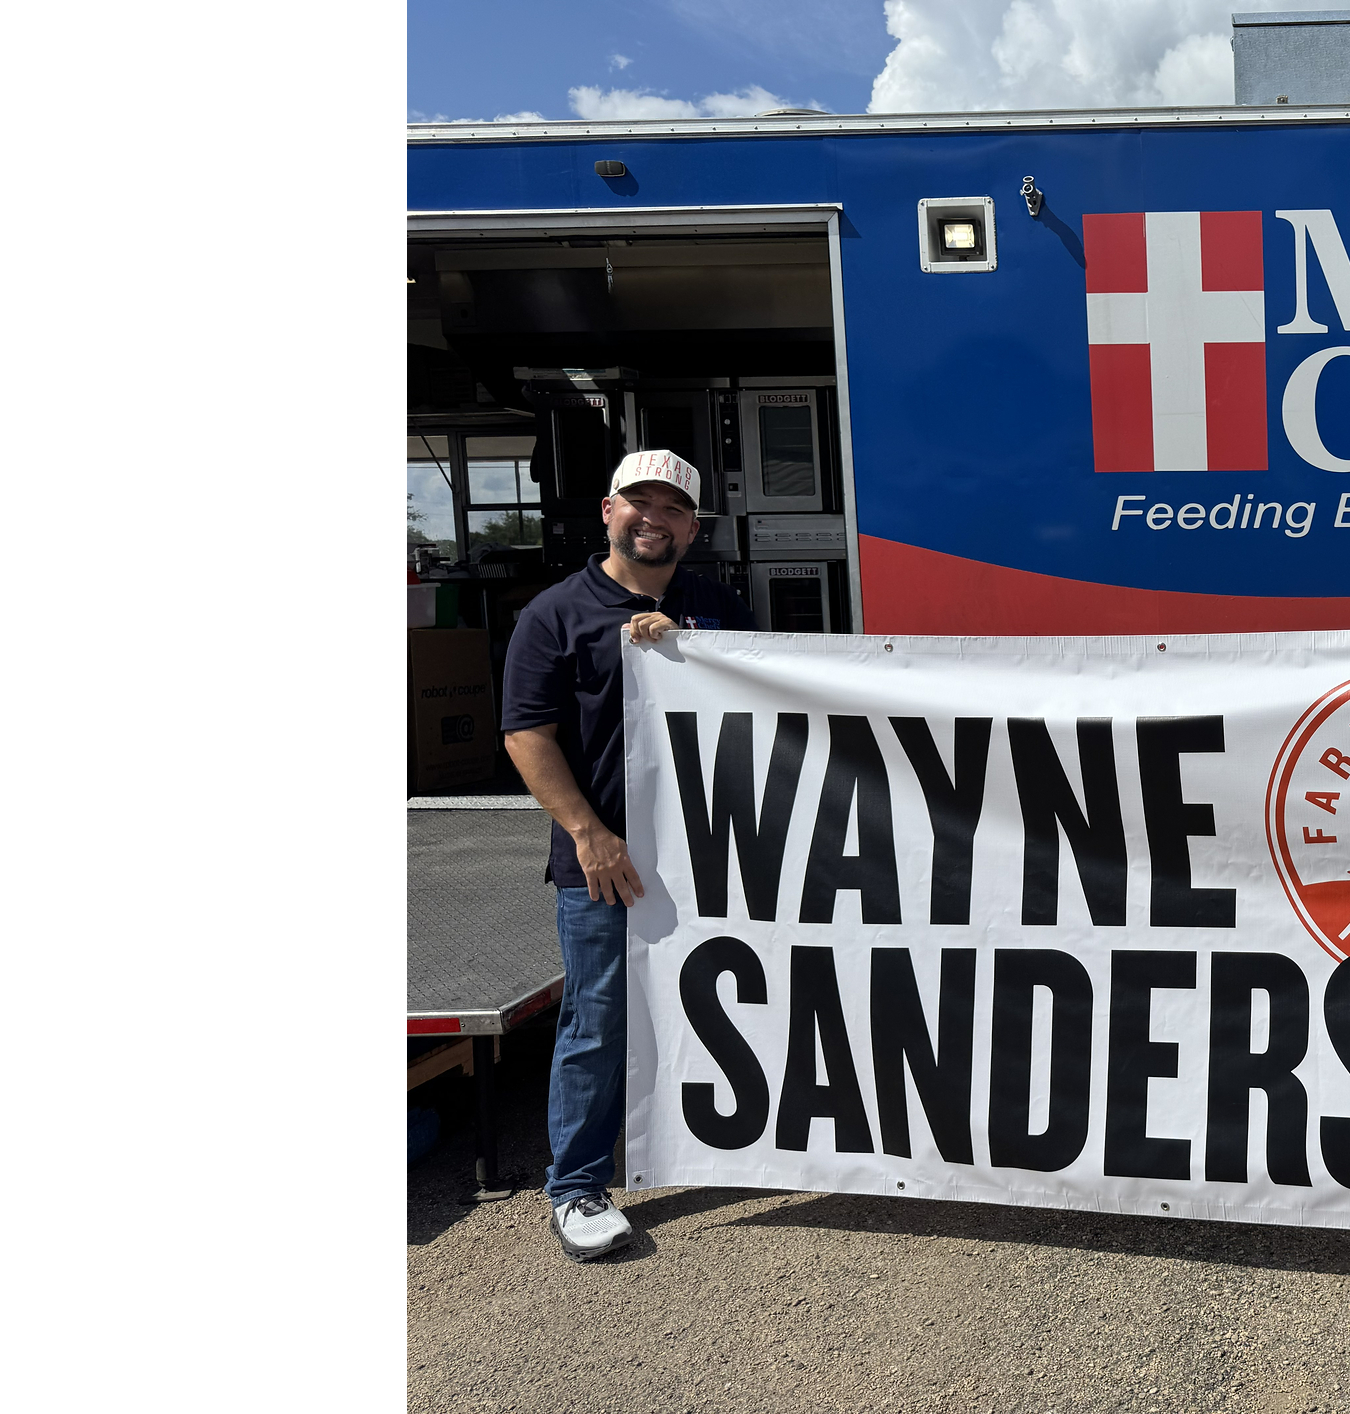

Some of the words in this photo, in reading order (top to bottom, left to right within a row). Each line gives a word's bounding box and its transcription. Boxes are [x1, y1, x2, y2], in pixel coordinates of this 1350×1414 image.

[759, 395, 807, 403] BLODGETT
[635, 466, 690, 491] STRONG
[638, 454, 692, 481] TEXAS
[1111, 493, 1316, 538] Feeding
[770, 567, 817, 576] BLODGETT
[421, 686, 448, 699] robot
[458, 684, 486, 697] coupe
[664, 711, 1237, 929] WAYNE
